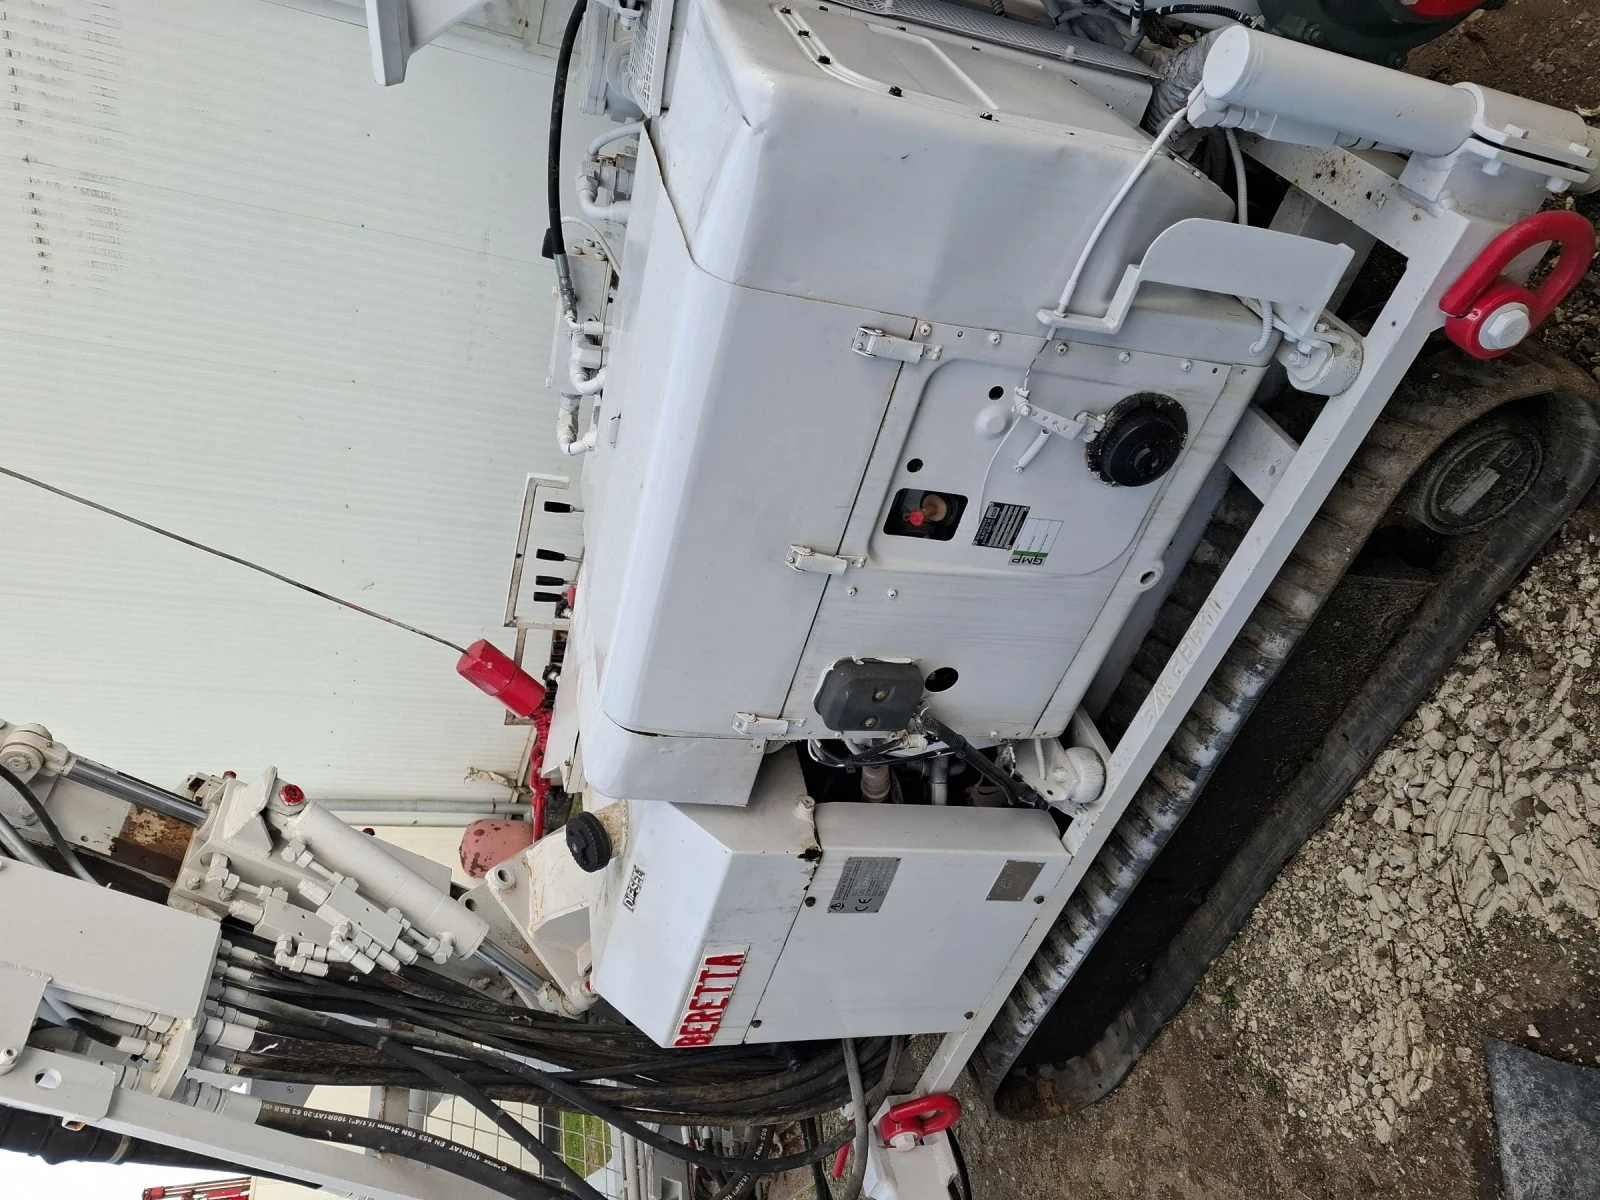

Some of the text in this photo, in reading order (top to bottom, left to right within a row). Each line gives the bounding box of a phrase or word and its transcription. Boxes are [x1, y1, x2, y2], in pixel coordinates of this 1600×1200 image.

[1011, 553, 1044, 566] GMP
[673, 953, 746, 1047] BERETTA
[274, 1105, 290, 1114] BAR
[376, 1123, 400, 1134] 31mm
[401, 1129, 417, 1138] 1SN
[418, 1134, 432, 1143] 853
[434, 1139, 445, 1147] EN
[449, 1145, 480, 1161] 100R1AT
